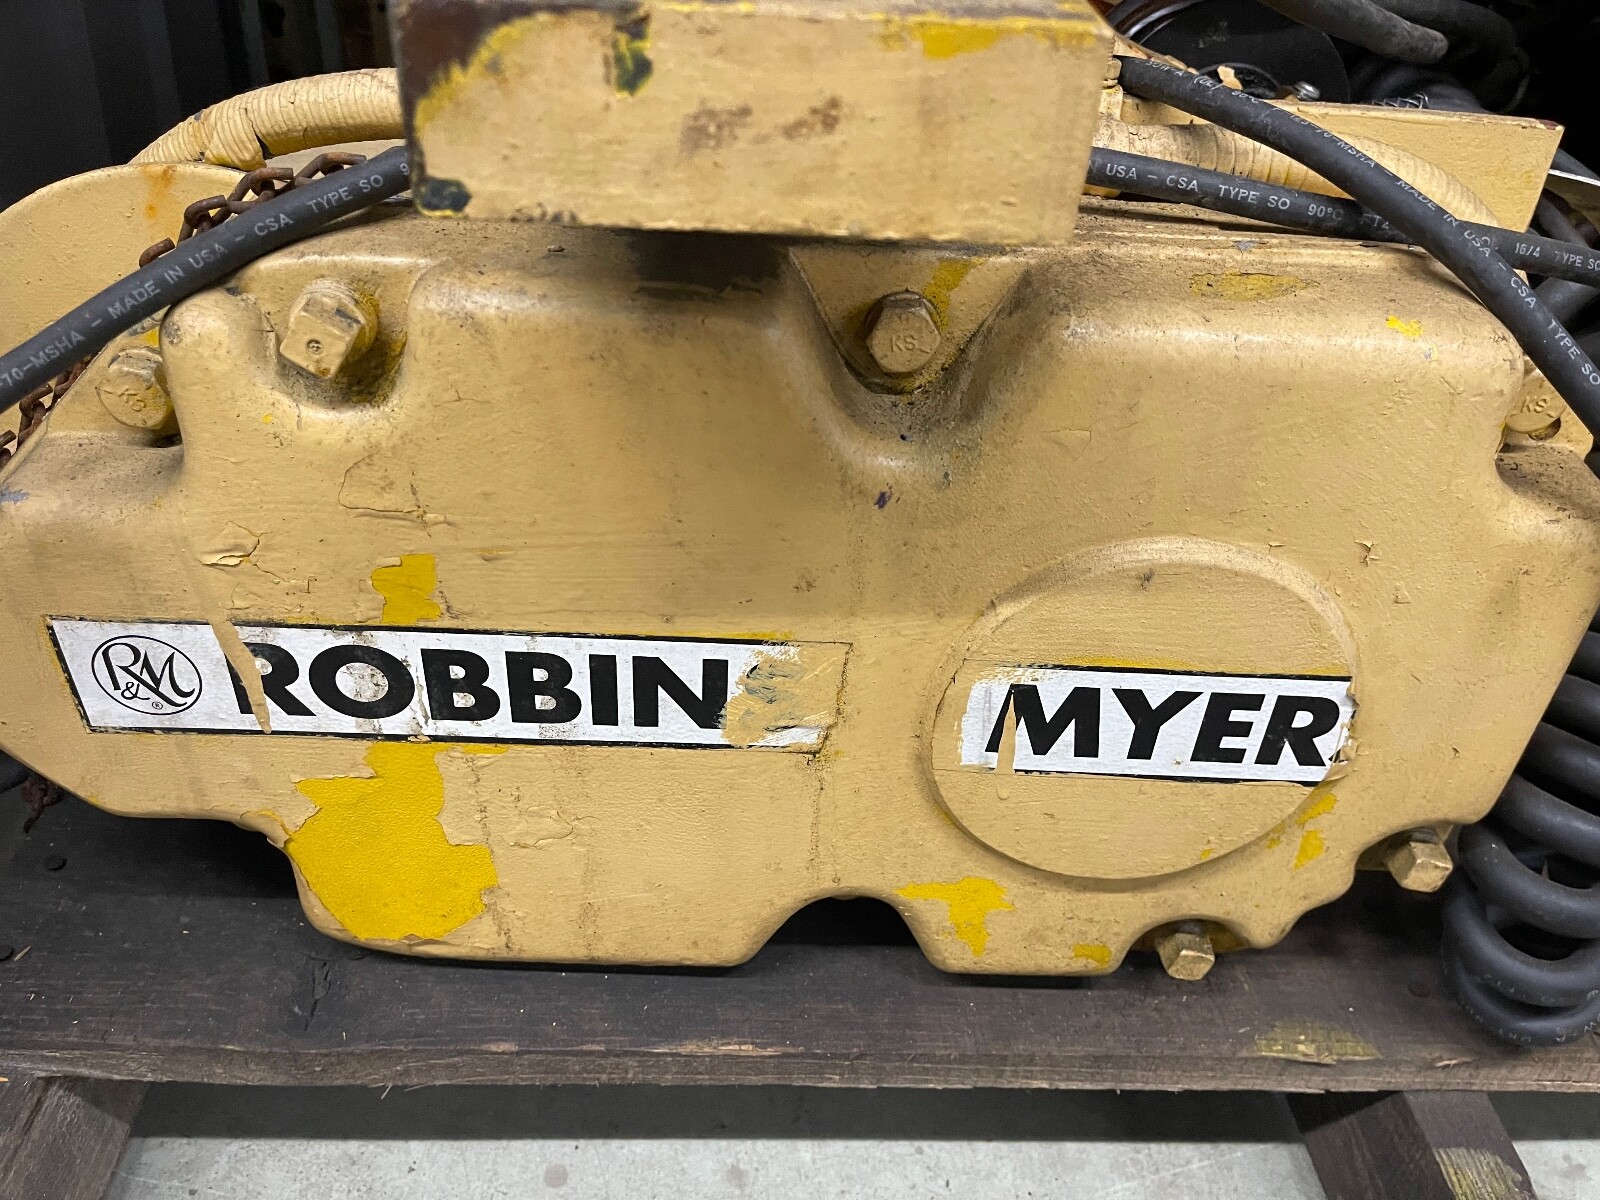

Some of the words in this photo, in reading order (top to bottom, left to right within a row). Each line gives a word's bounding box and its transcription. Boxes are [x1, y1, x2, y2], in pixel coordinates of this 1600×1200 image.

[1106, 163, 1138, 180] USA
[1166, 174, 1199, 192] CSA
[1218, 184, 1260, 204] TYPE
[1267, 195, 1291, 210] SO
[107, 280, 162, 320] MADE
[164, 265, 186, 285] IN
[188, 243, 229, 270] USA
[254, 212, 295, 236] CSA
[306, 186, 354, 214] TYPE
[358, 174, 384, 193] SO
[1554, 250, 1584, 267] TYPE
[1463, 229, 1491, 258] USA
[1510, 275, 1537, 309] CSA
[1548, 318, 1581, 360] TYPE
[1581, 363, 1600, 386] SO
[223, 641, 760, 731] ROBBIN
[984, 683, 1347, 768] MYER
